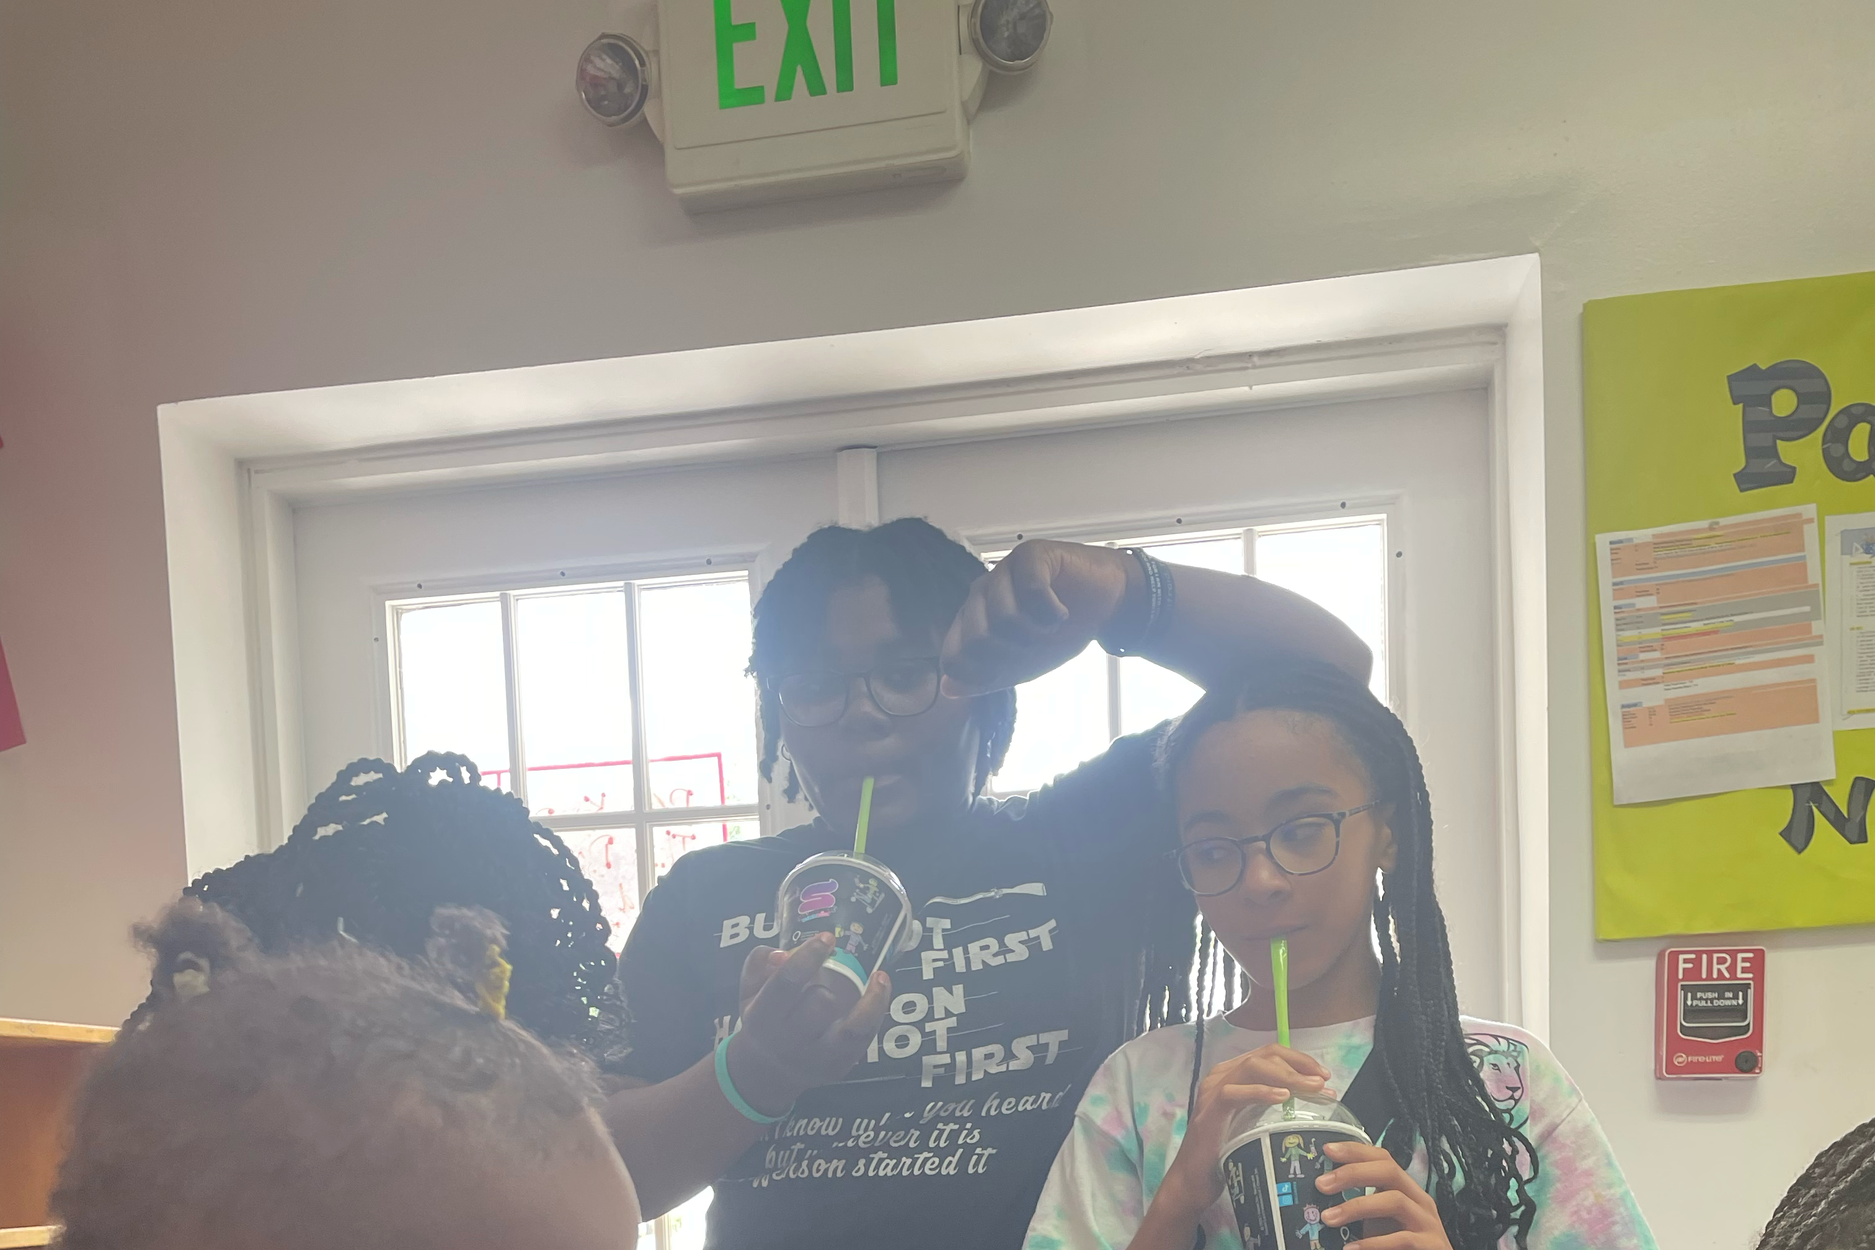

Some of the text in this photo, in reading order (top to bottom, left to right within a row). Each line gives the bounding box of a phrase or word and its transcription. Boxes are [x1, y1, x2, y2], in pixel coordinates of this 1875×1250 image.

[1727, 359, 1875, 493] Pa
[1779, 776, 1875, 855] N
[719, 912, 781, 948] BU
[921, 918, 1057, 980] FIRST
[1678, 953, 1754, 979] FIRE
[890, 984, 966, 1023] ON
[1697, 991, 1718, 999] PUSH
[921, 1029, 1069, 1087] FIRST
[919, 1101, 976, 1124] you
[981, 1084, 1072, 1117] heard
[928, 1122, 960, 1148] it
[957, 1122, 982, 1145] is
[851, 1148, 966, 1178] started
[966, 1146, 998, 1175] it
